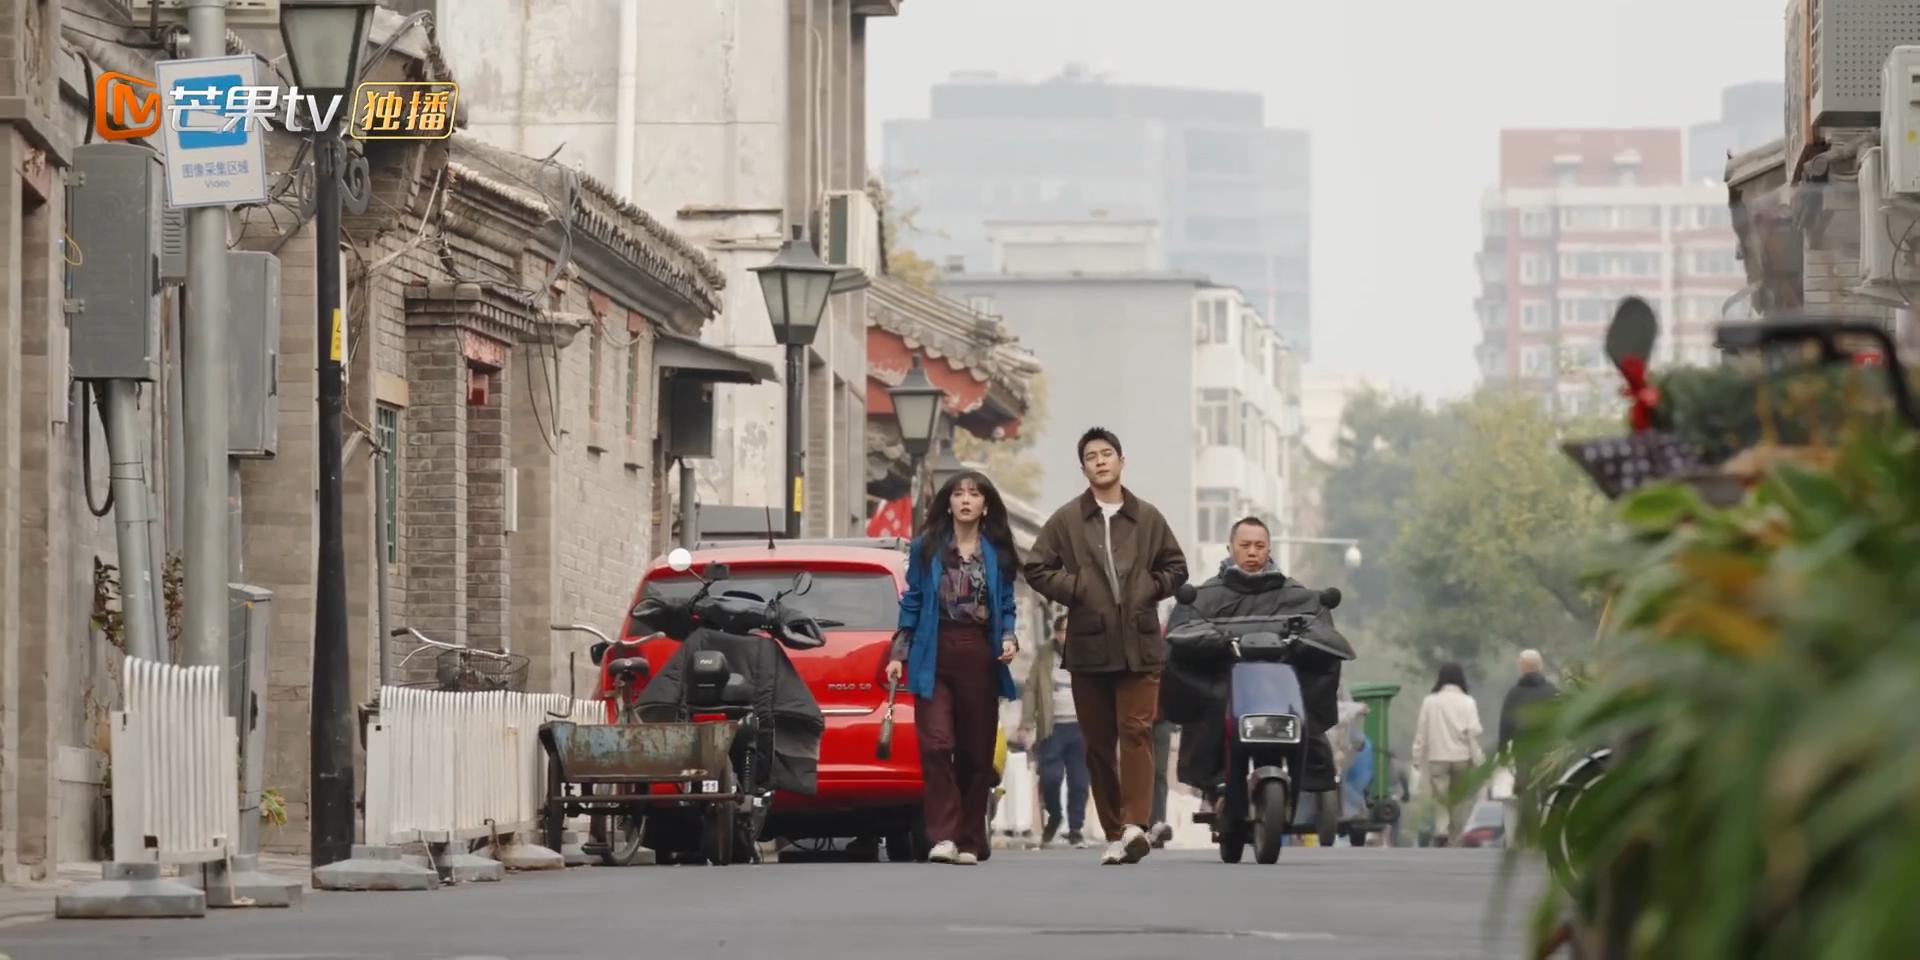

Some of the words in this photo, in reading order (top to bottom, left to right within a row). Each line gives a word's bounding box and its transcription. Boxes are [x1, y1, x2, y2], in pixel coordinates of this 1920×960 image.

[182, 160, 249, 178] 图像采集区域
